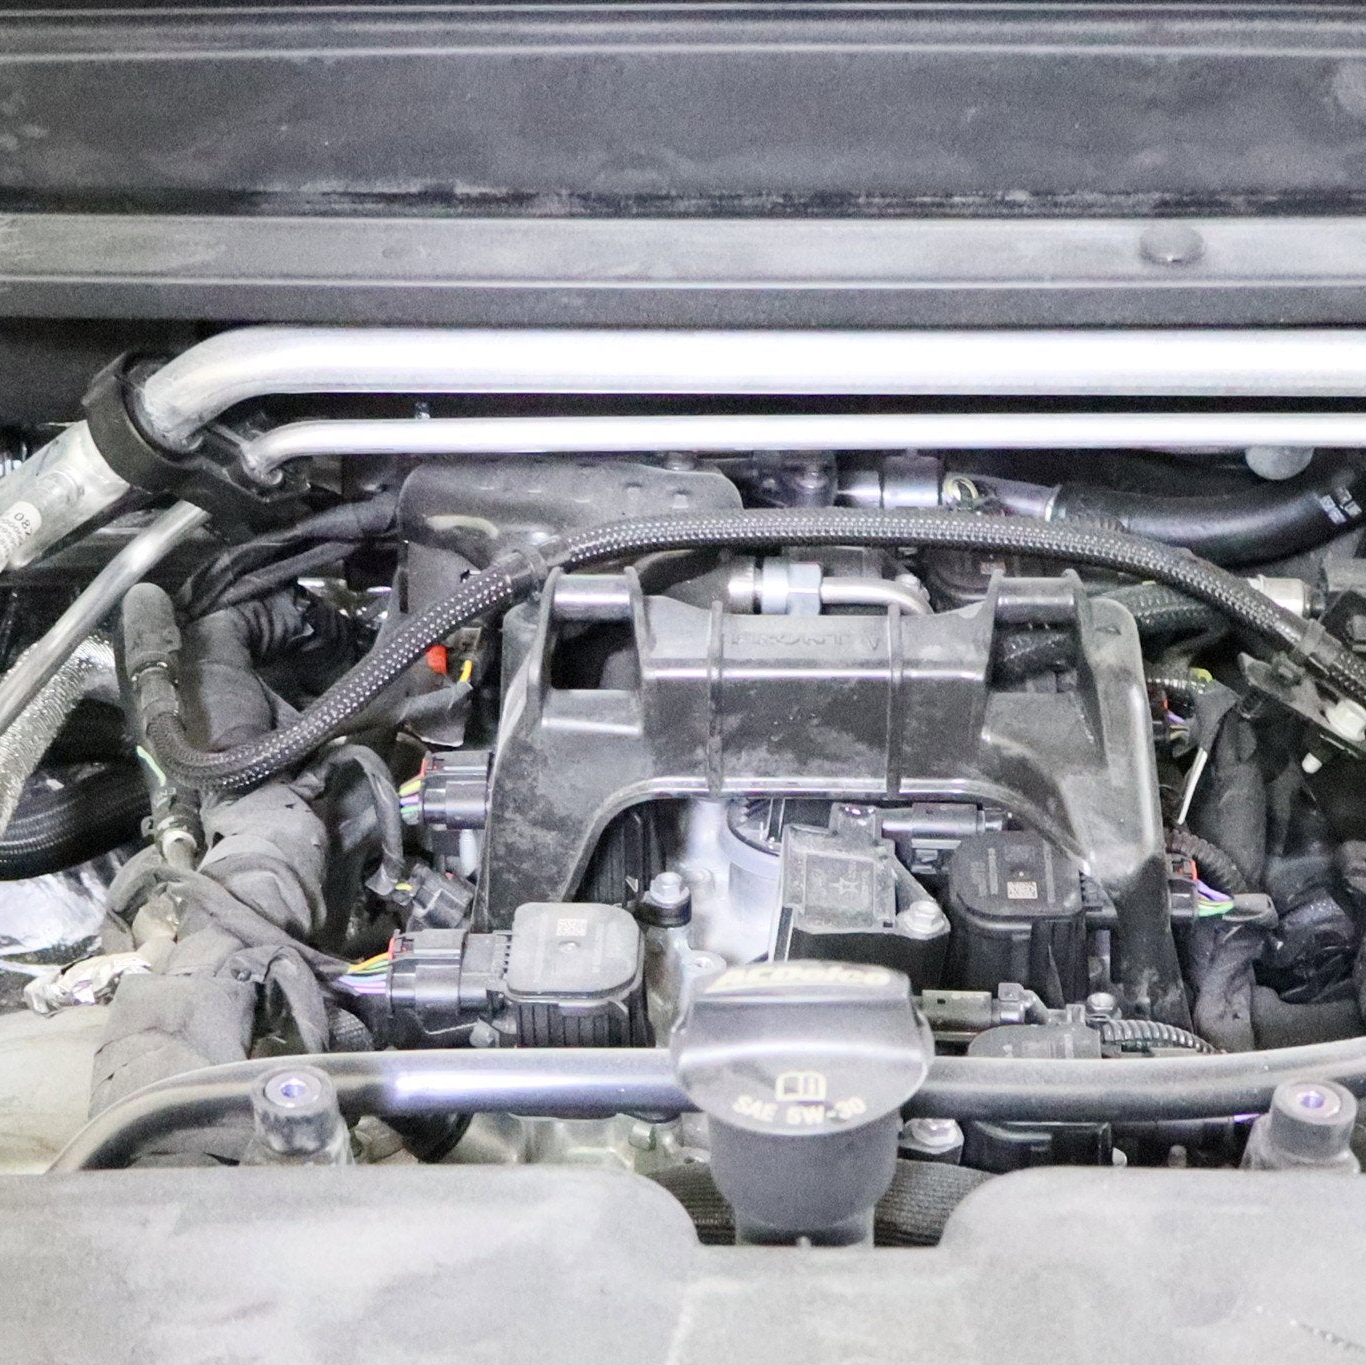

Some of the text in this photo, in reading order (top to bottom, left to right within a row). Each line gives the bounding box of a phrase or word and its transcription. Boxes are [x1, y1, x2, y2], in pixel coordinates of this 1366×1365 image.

[706, 966, 891, 993] ACDelco
[733, 1095, 867, 1125] SAE 5W-30
